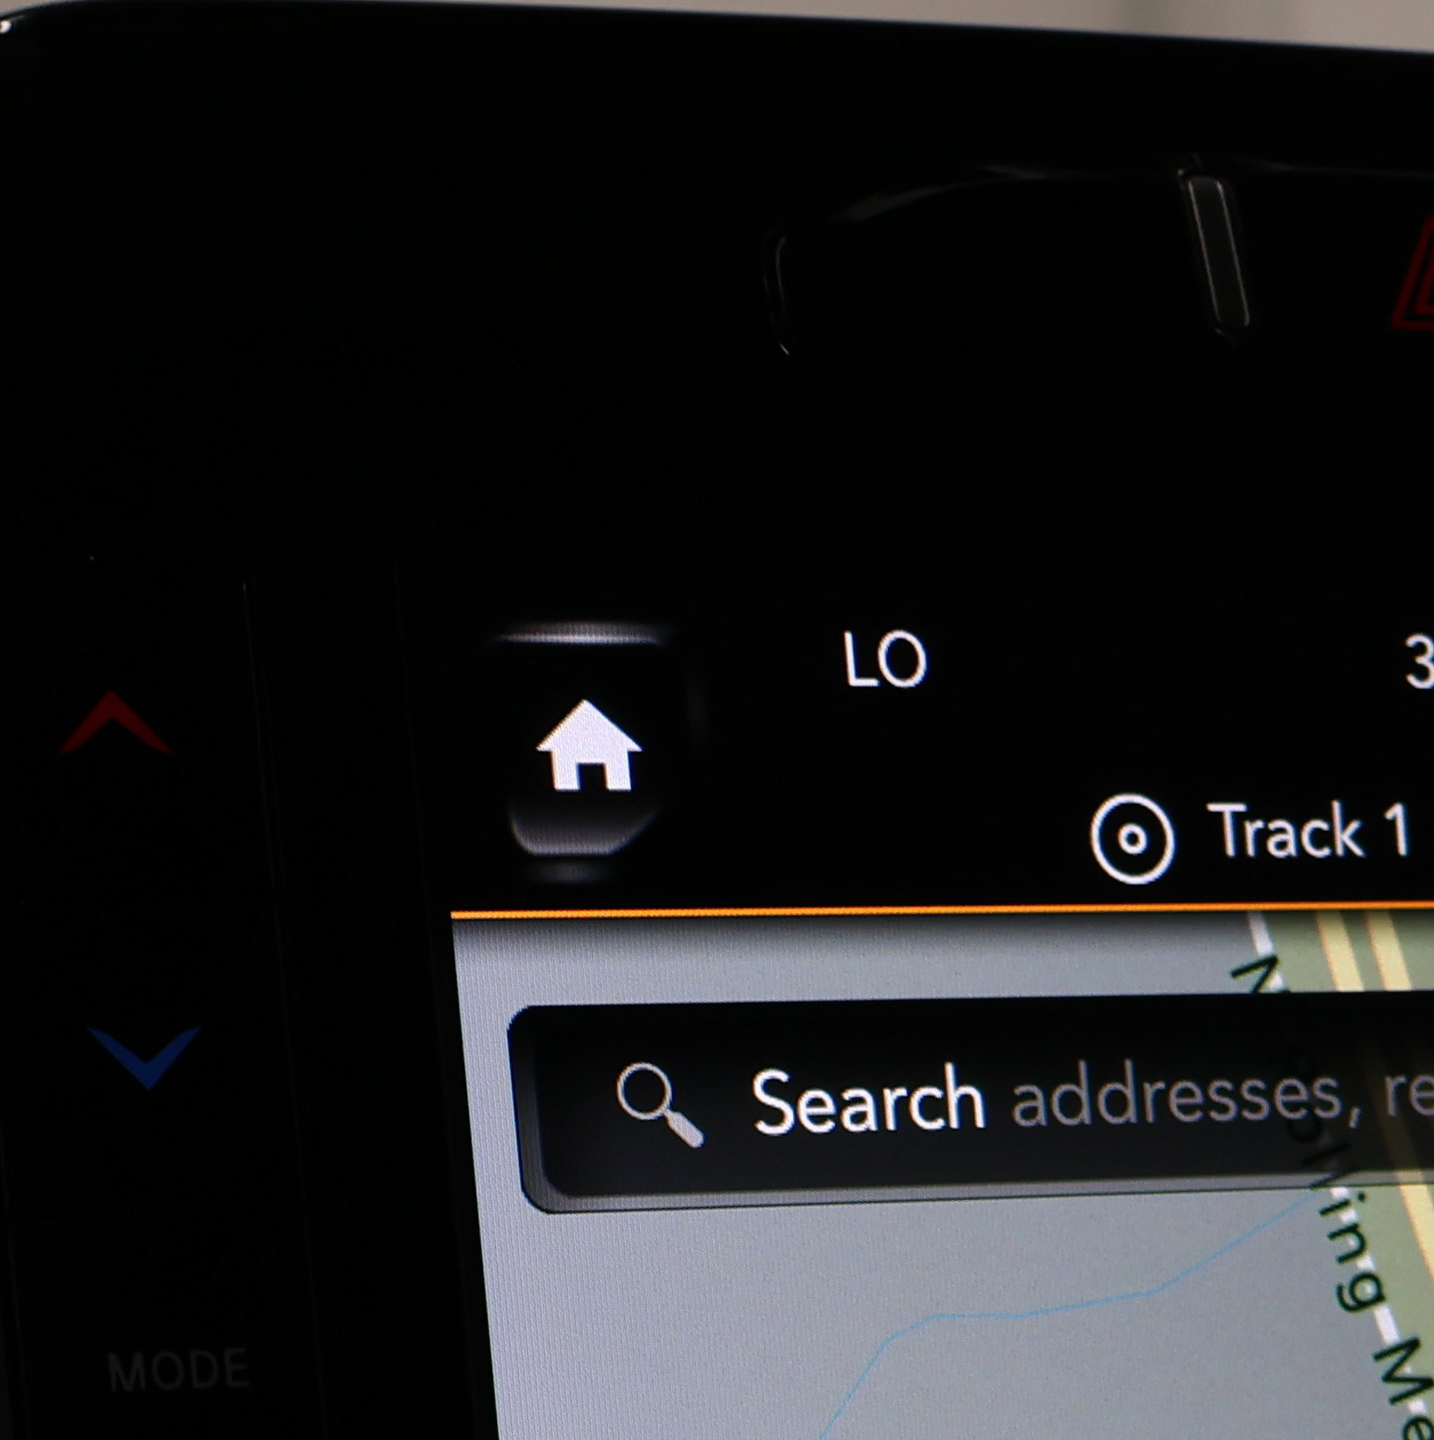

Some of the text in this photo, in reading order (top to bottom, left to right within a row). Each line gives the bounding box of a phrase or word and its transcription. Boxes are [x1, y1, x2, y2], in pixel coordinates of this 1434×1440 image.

[844, 630, 928, 688] LO
[1207, 800, 1408, 858] Track 1
[753, 1062, 986, 1136] Search
[1012, 1059, 1361, 1129] addresses,
[108, 1347, 250, 1392] MODE
